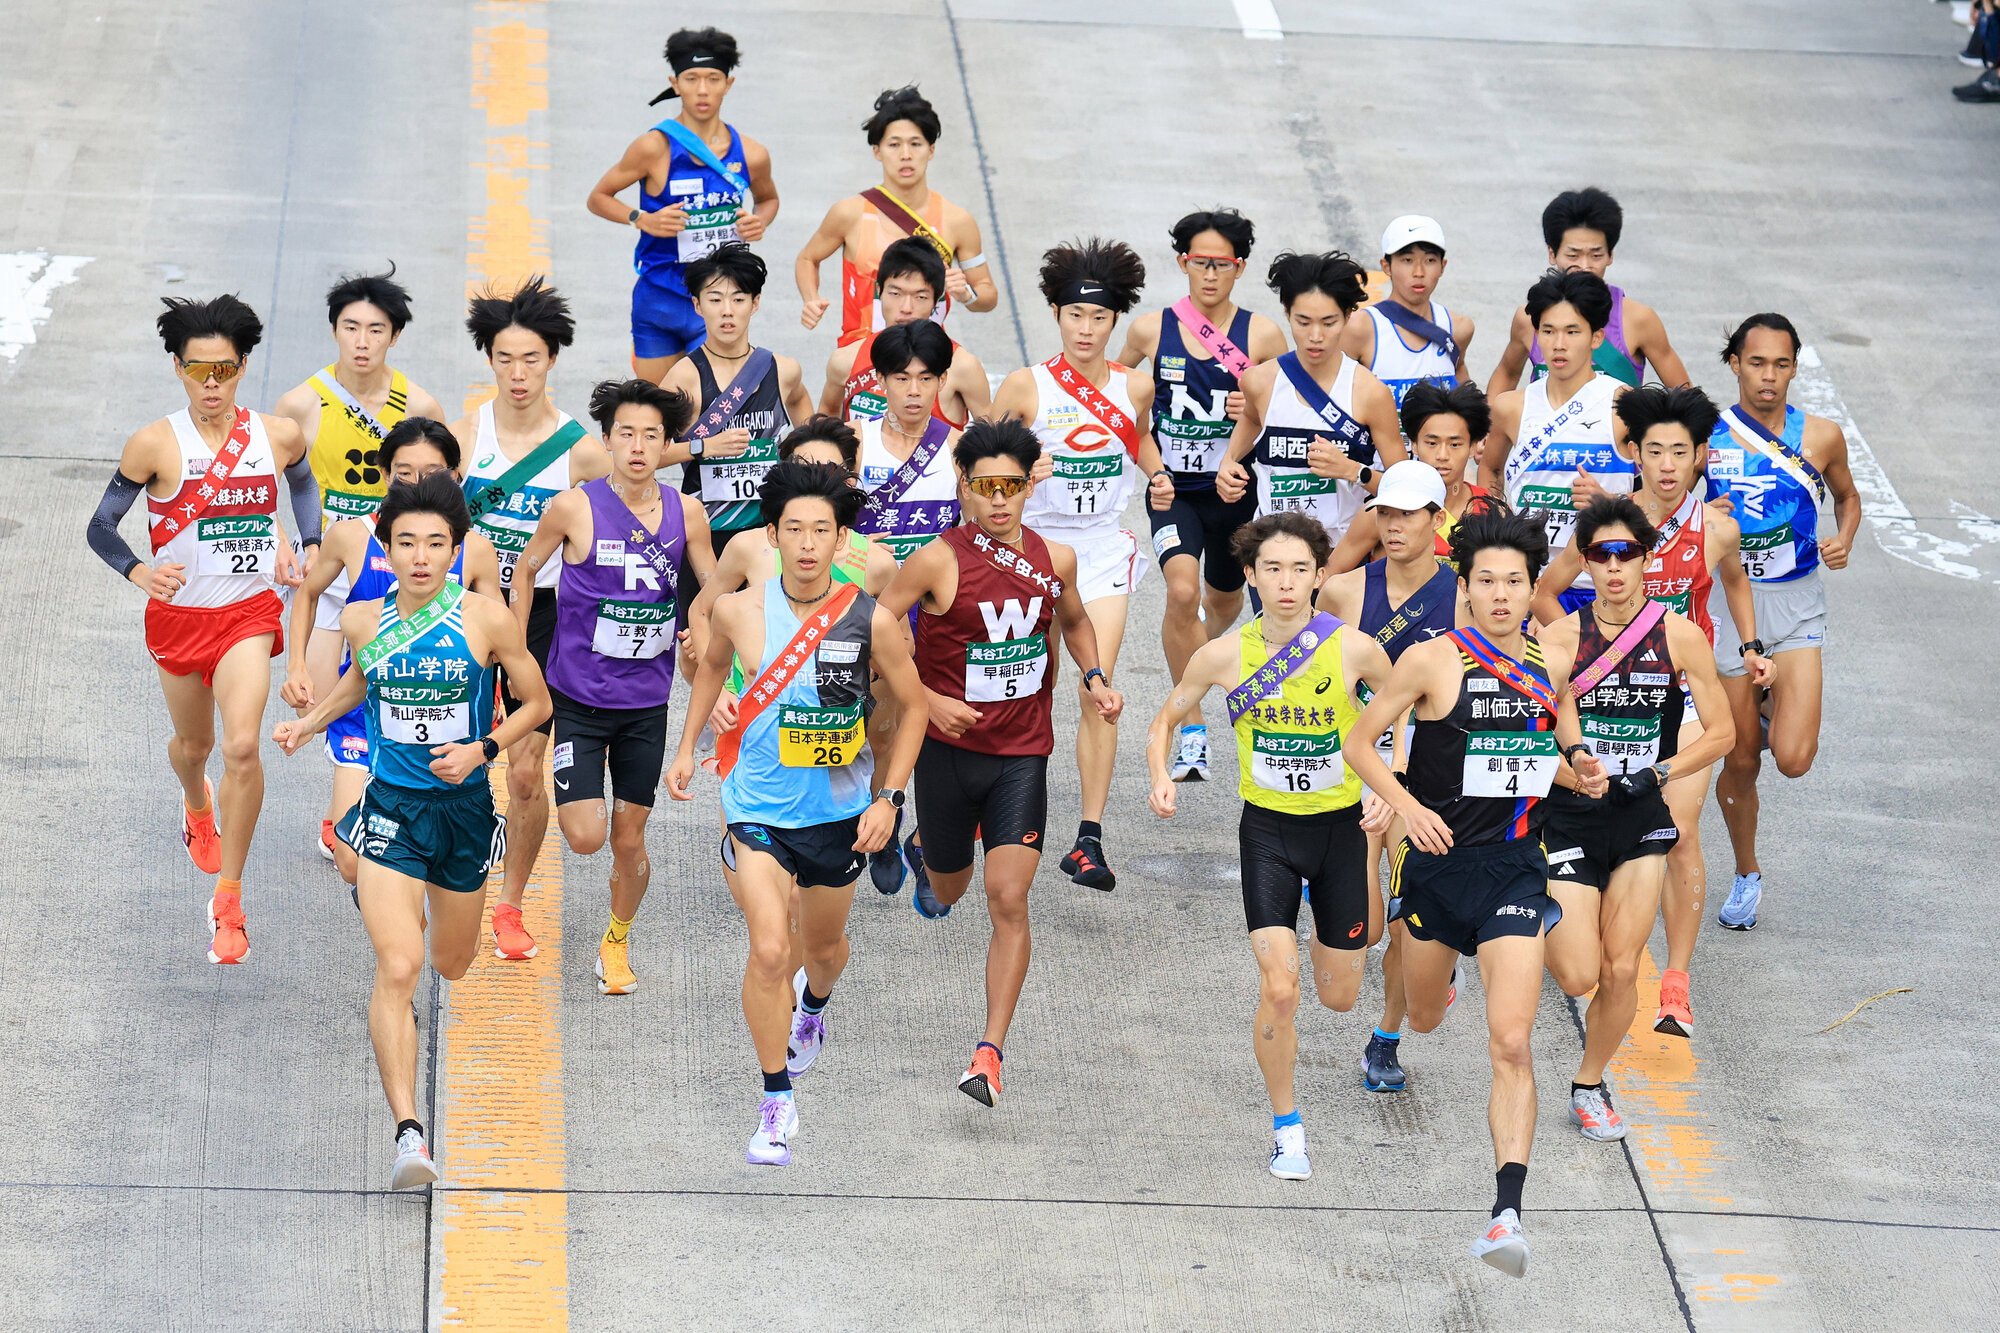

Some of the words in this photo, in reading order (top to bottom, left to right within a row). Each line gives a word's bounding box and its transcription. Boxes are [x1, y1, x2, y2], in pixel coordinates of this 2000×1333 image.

[1061, 369, 1125, 429] 中央大学
[1170, 384, 1230, 422] N
[1159, 418, 1233, 437] 長谷工グループ
[1171, 438, 1216, 453] 日本大
[1052, 457, 1121, 475] 長谷工グループ
[1181, 453, 1204, 471] 14
[1711, 467, 1740, 476] OILES
[164, 420, 250, 533] 大阪経済大学
[868, 467, 889, 480] HRS
[732, 480, 755, 499] 10
[1067, 479, 1108, 494] 中央大
[1075, 494, 1096, 514] 11
[1271, 496, 1318, 512] 関西大
[211, 538, 276, 555] 大阪経済大
[1739, 549, 1776, 562] 海大
[231, 553, 260, 574] 22
[624, 553, 662, 591] R
[973, 532, 1062, 599] 早稲田大学
[1741, 562, 1765, 578] 15
[501, 566, 514, 584] 9
[602, 601, 675, 621] 長谷工グループ
[977, 595, 1044, 644] W
[360, 600, 446, 667] 青山学院大学
[617, 624, 663, 639] 立教大
[632, 639, 645, 658] 7
[970, 638, 1044, 662] 長谷工グループ
[375, 656, 470, 682] 青山学院
[983, 660, 1037, 681] 早稲田大
[1642, 674, 1669, 683] アサガミ
[1004, 679, 1018, 698] 5
[1228, 645, 1303, 714] 中央学院大学
[379, 685, 466, 702] 長谷工グループ
[1579, 687, 1668, 710] 国学院大学
[390, 704, 456, 722] 青山学院大
[782, 703, 862, 726] 長谷工グループ
[1250, 704, 1336, 727] 中央学院大学
[1471, 697, 1546, 719] 創価大学
[414, 723, 430, 743] 3
[788, 726, 859, 746] 日本学連選抜
[1584, 718, 1661, 738] 長谷工グループ
[1256, 734, 1338, 752] 長谷工グループ
[1469, 737, 1555, 752] 長谷工グループ
[1596, 740, 1654, 757] 國學院大
[813, 746, 843, 766] 26
[1264, 756, 1332, 772] 中央学院大
[1487, 757, 1539, 773] 創価大
[1619, 757, 1629, 777] 1
[1284, 773, 1311, 792] 16
[1505, 774, 1519, 796] 4
[1495, 904, 1538, 920] 創価大学
